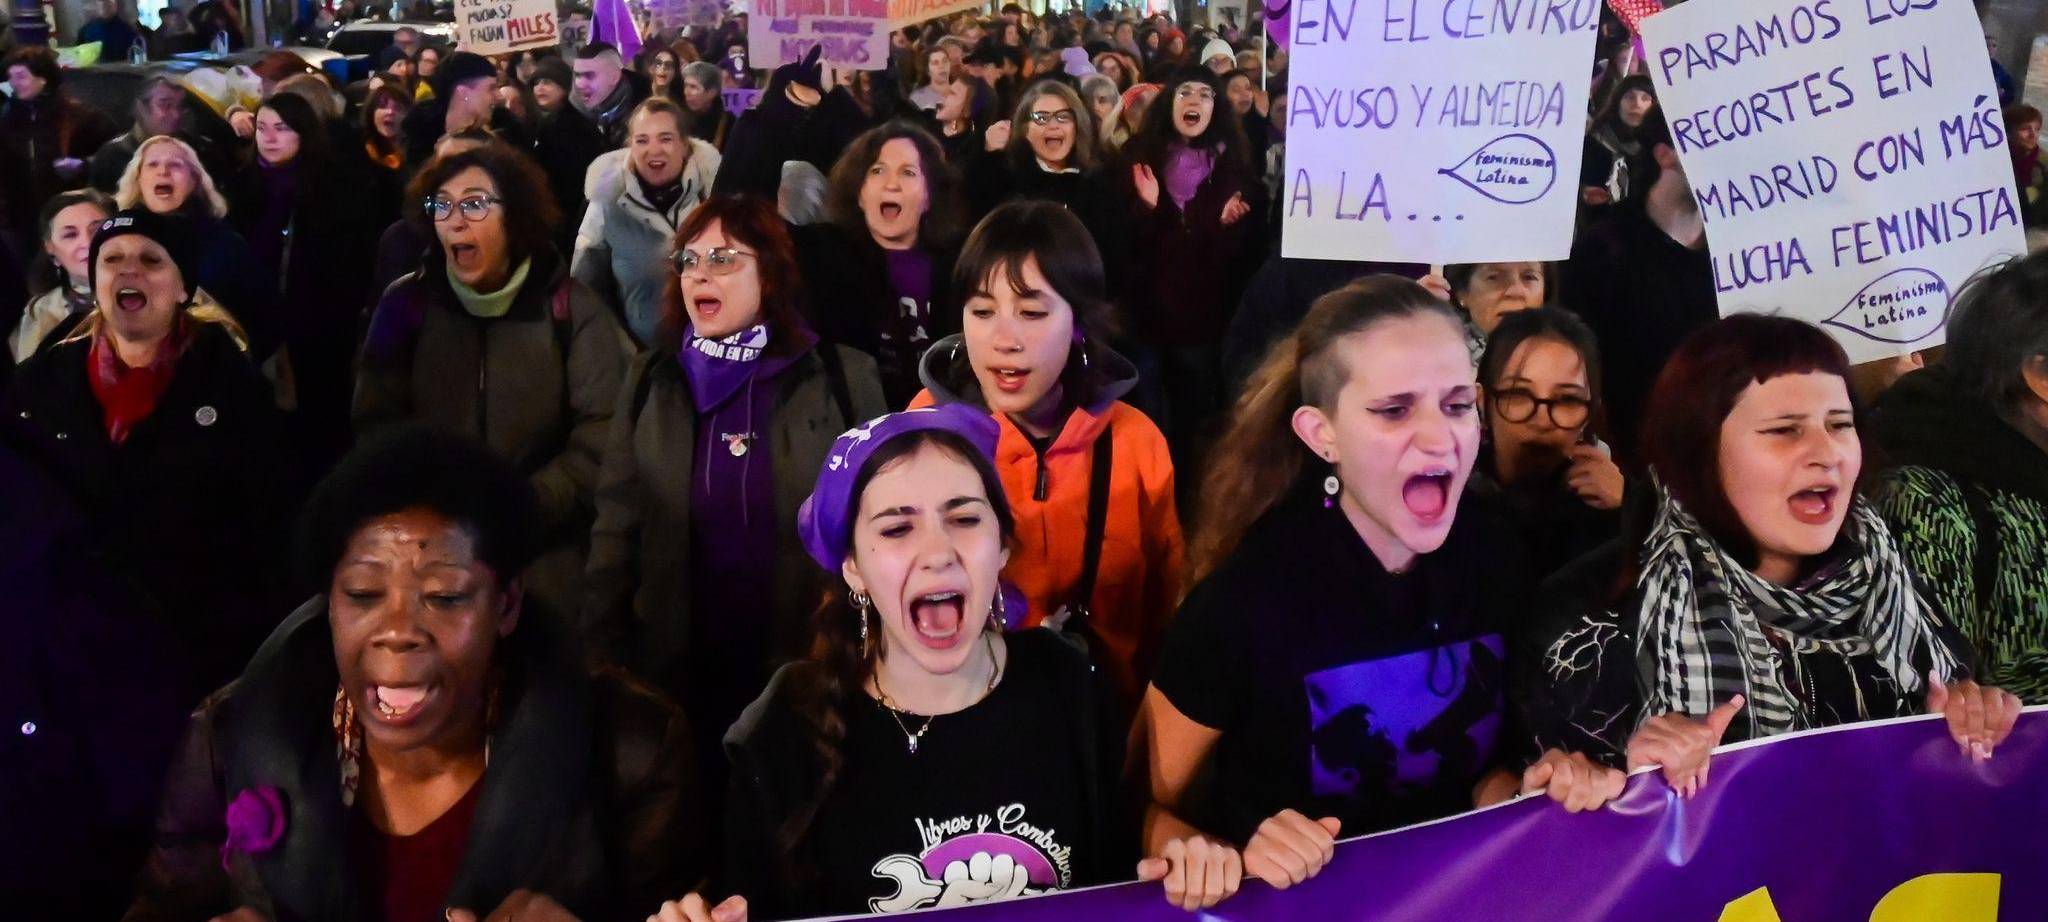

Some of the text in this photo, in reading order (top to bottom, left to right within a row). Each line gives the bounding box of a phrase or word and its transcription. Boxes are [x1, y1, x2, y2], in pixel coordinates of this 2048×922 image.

[507, 12, 555, 41] MILES
[1295, 0, 1355, 45] EN
[1384, 0, 1429, 42] EL
[1659, 1, 1841, 86] PARAMOS
[1290, 81, 1564, 129] AYUSO Y ALMEIDA
[1673, 46, 1933, 153] RECORTES EN
[1696, 95, 2004, 223] MADRID CON MÁS
[1289, 168, 1312, 217] A
[1336, 171, 1391, 221] LA
[1712, 187, 2018, 293] LUCHA FEMINISTA
[1864, 305, 1927, 328] Latina
[915, 816, 973, 859] Libres
[977, 814, 991, 834] y
